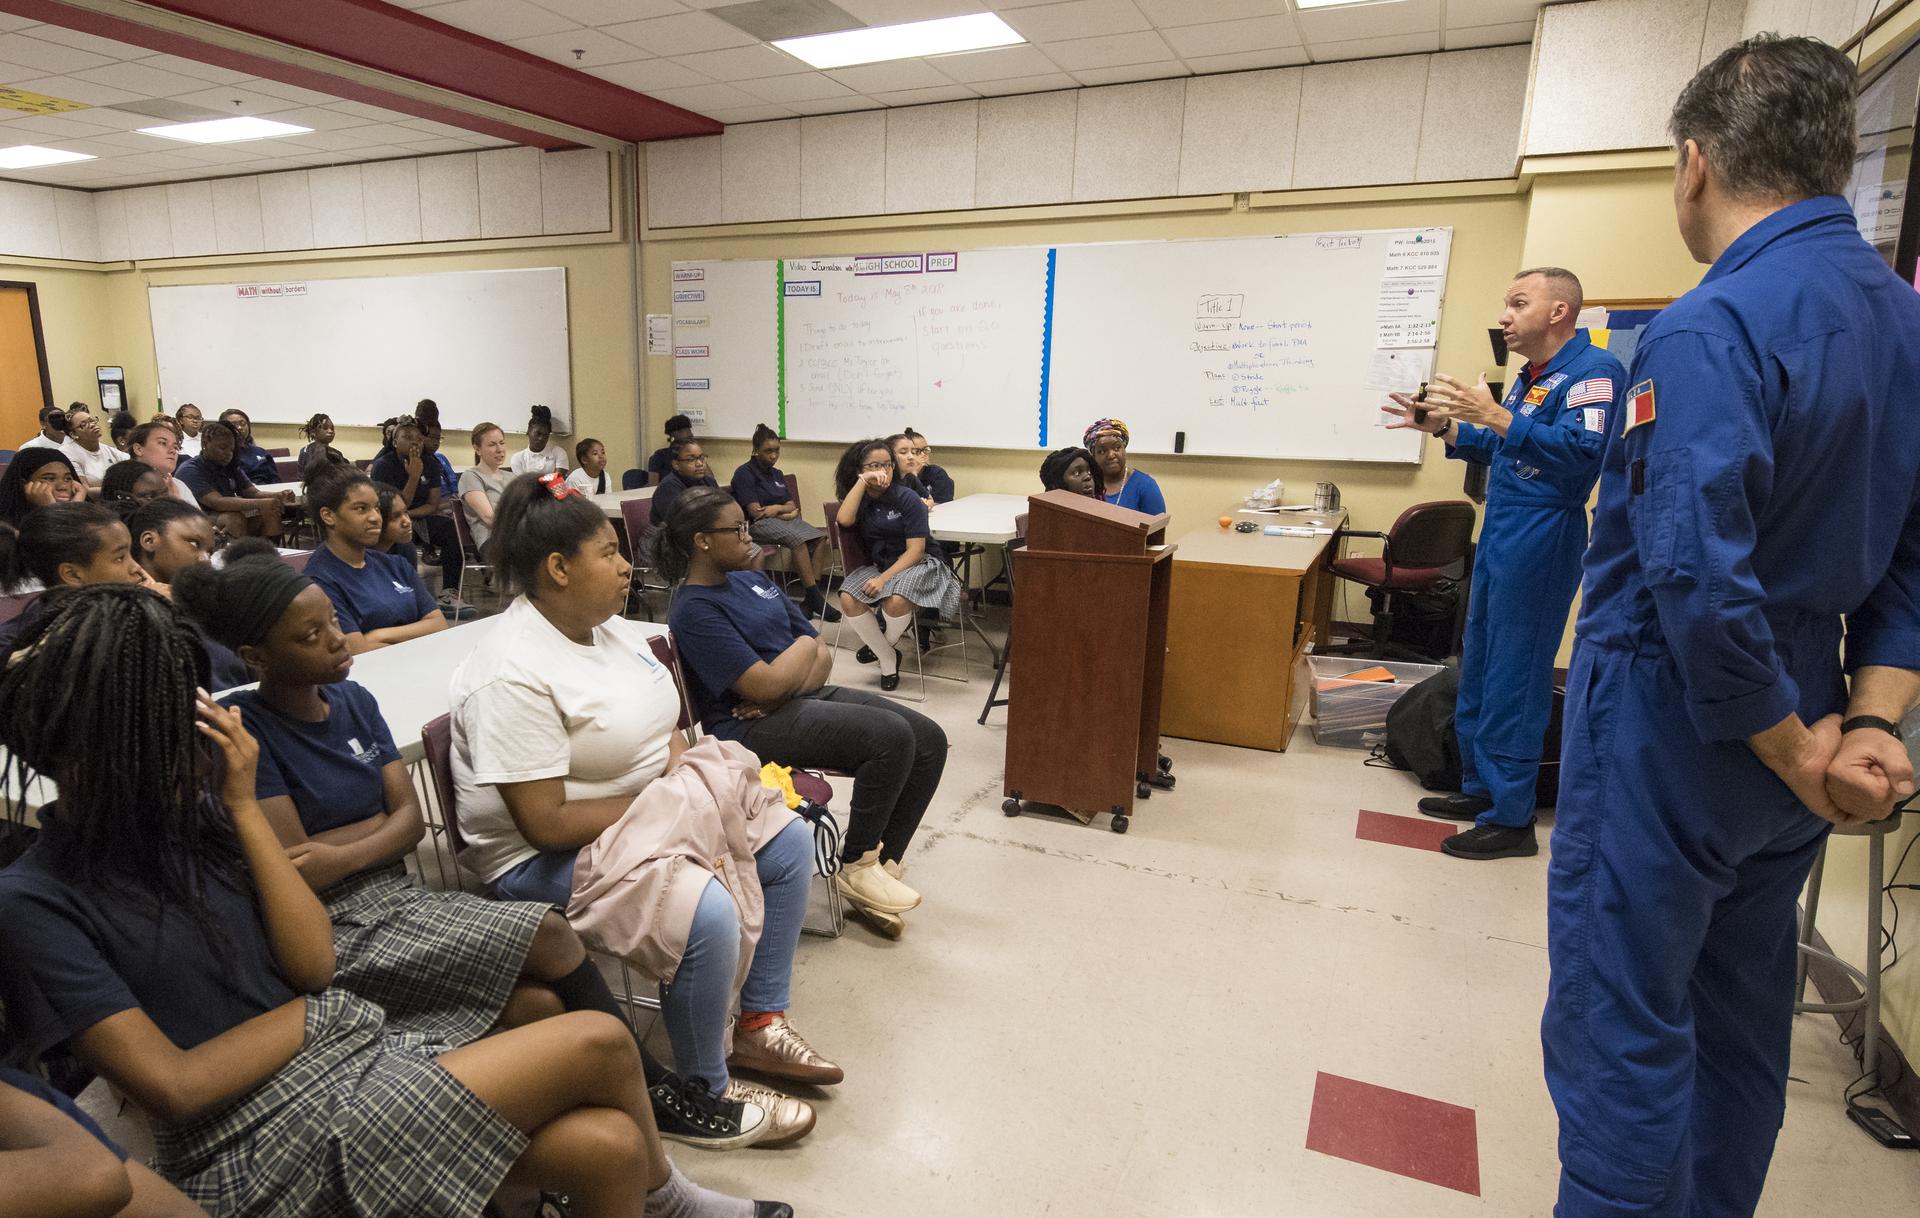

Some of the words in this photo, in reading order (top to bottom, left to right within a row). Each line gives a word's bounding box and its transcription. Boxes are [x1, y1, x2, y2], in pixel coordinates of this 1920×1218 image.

[884, 260, 919, 270] SCHOOL
[930, 257, 954, 267] PREP
[238, 287, 258, 297] MATH
[261, 287, 282, 295] without
[285, 285, 306, 293] borders
